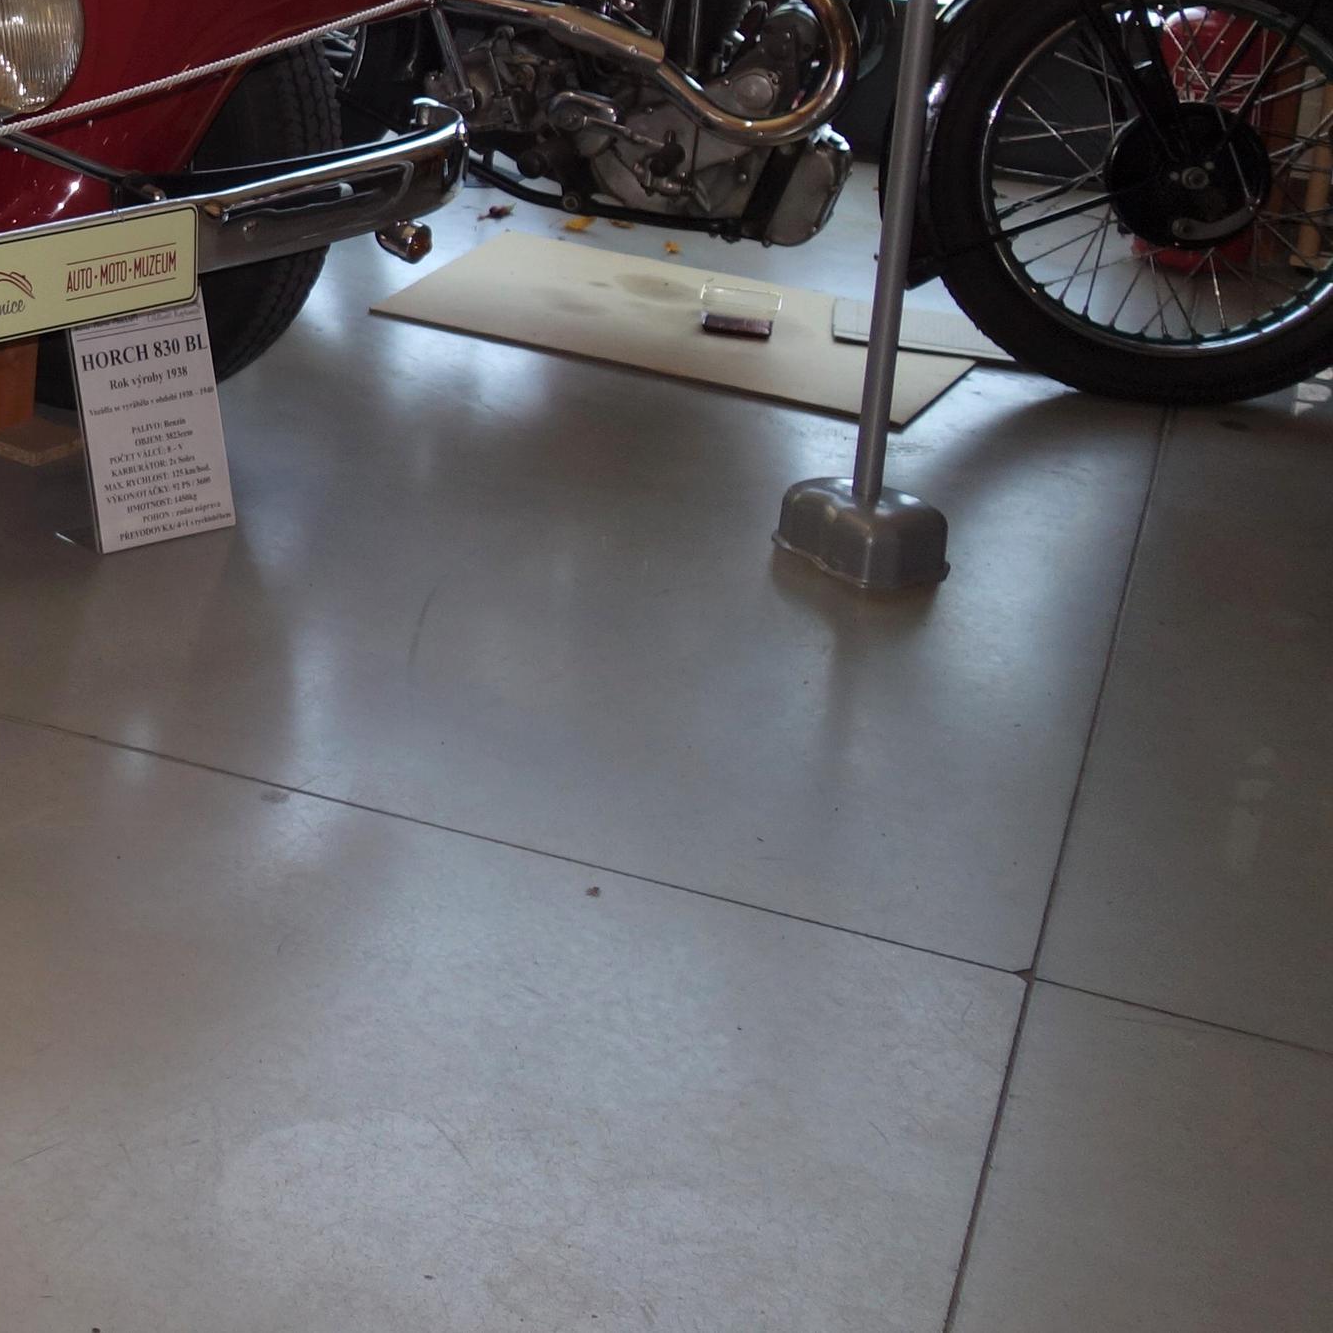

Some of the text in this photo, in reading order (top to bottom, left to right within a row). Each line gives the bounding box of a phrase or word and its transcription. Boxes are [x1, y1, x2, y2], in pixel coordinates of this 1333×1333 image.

[66, 251, 176, 293] AUTO MOTO MUZEUM
[81, 332, 207, 372] HORCH 830 BL
[109, 365, 188, 390] Rok výroby 1938
